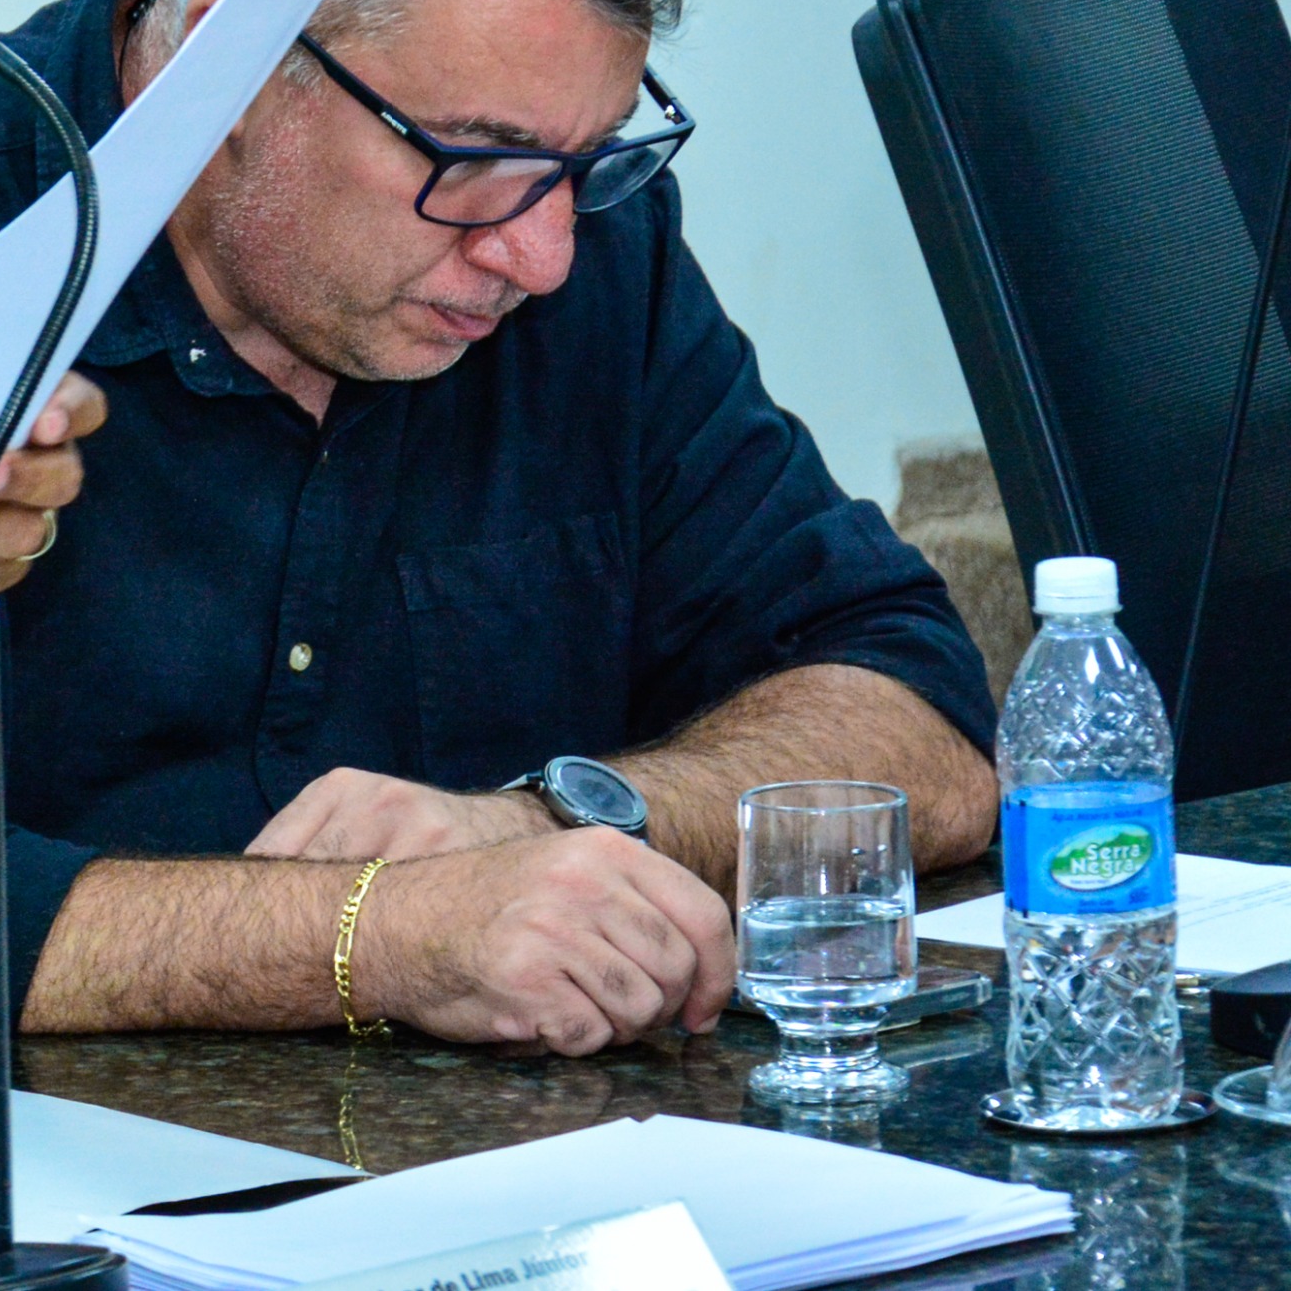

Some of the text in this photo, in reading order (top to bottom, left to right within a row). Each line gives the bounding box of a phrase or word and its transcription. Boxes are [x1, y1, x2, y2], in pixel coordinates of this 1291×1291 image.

[1086, 843, 1141, 861] Serra
[1070, 857, 1135, 879] Negra
[460, 1266, 520, 1291] Lima
